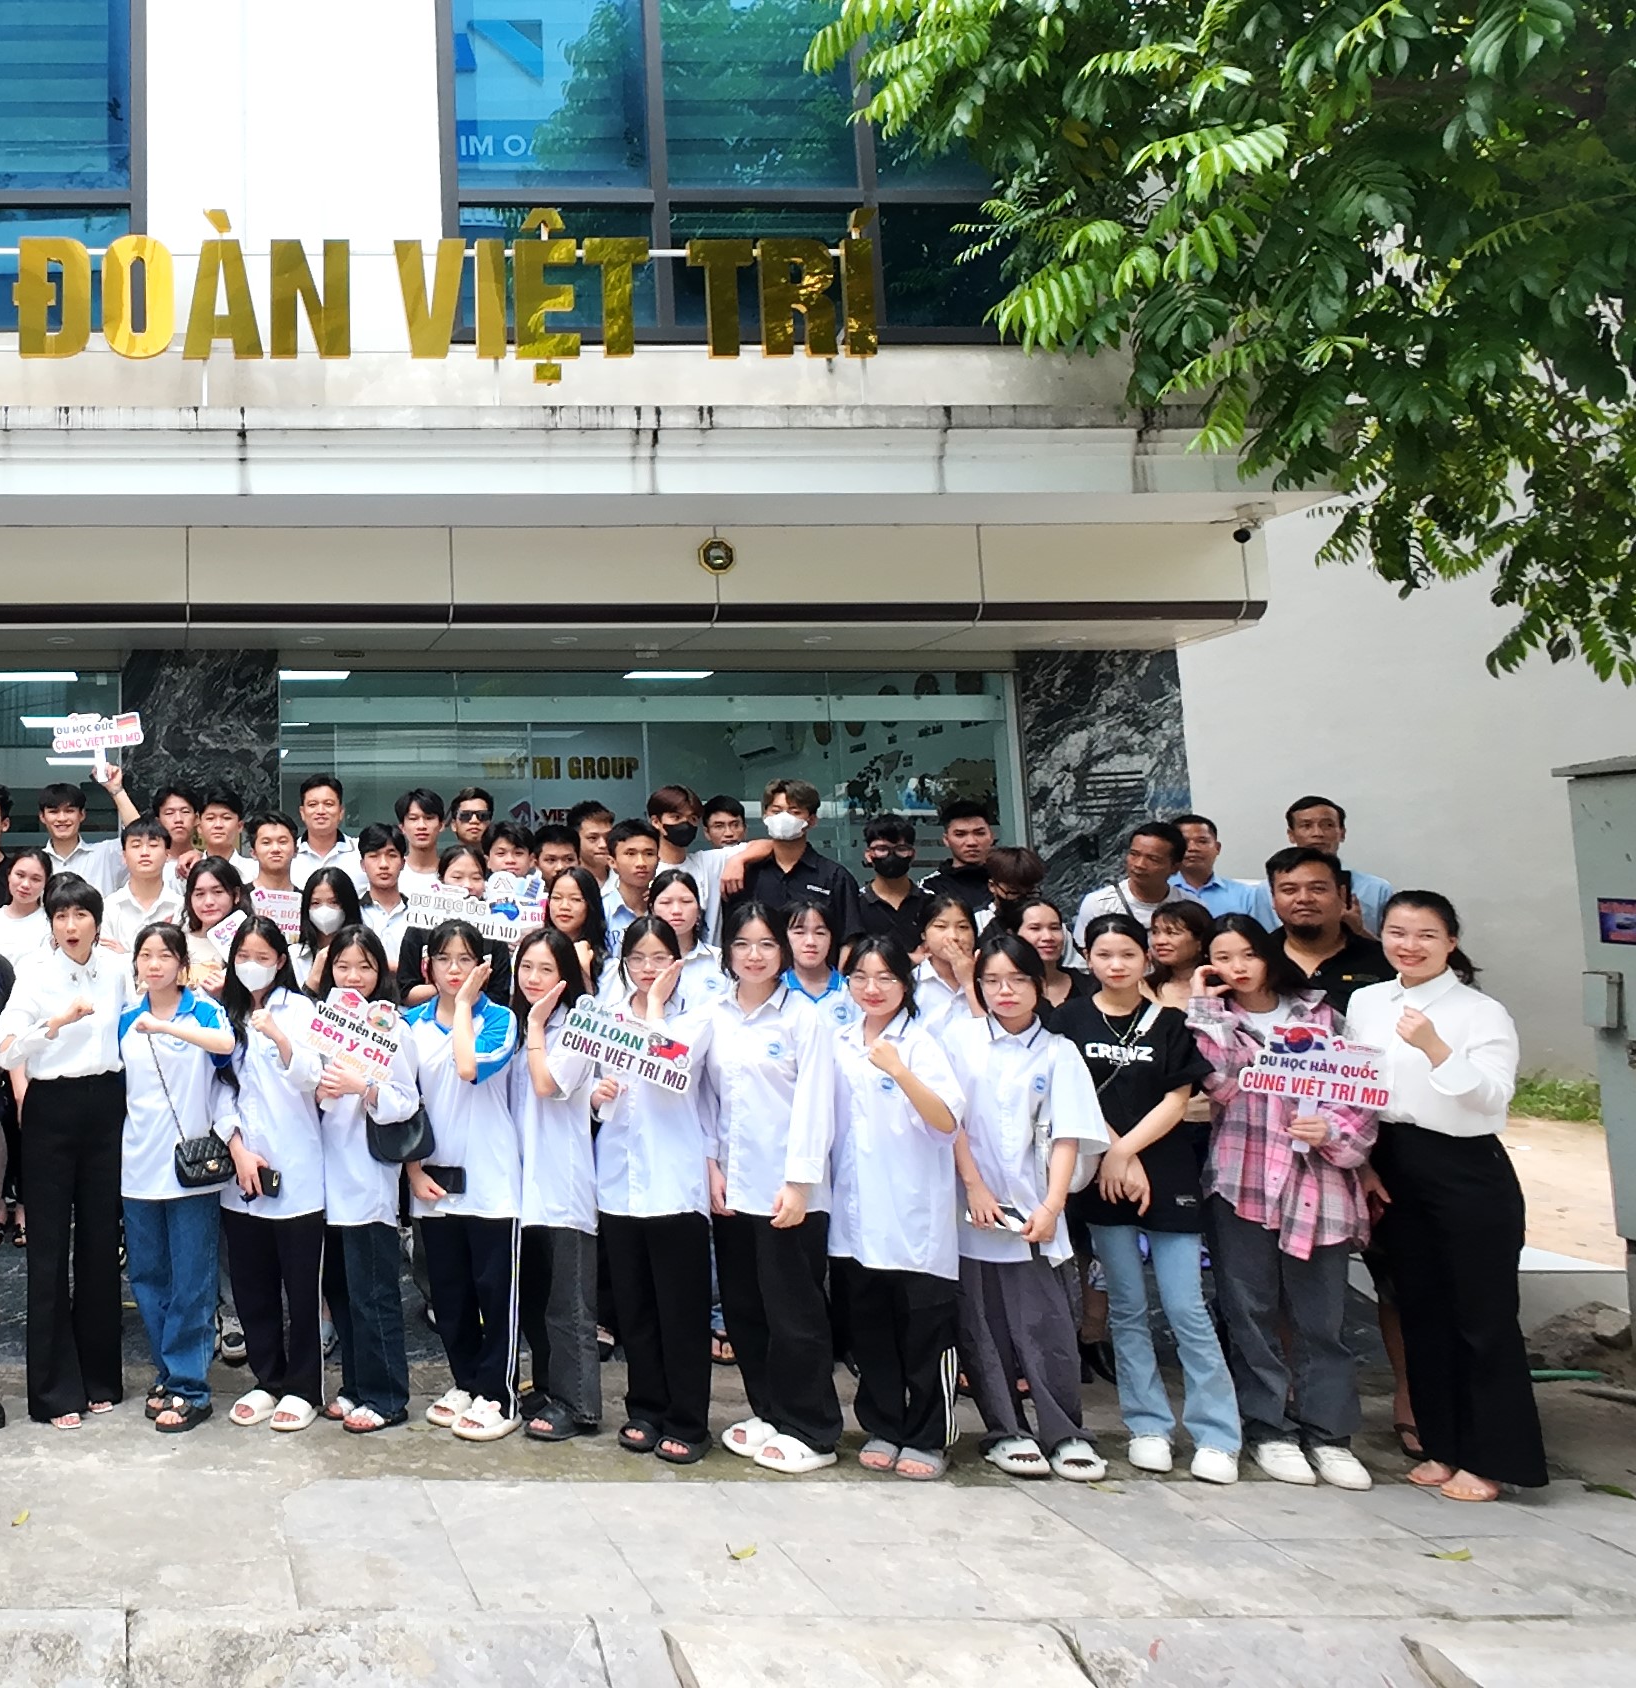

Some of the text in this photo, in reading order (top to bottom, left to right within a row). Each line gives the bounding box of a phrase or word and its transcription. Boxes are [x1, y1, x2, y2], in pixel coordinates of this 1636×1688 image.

[12, 208, 351, 360] ĐOÀN
[393, 208, 651, 385] VIỆT
[686, 207, 879, 360] TRÍ
[56, 726, 70, 735] DU
[125, 732, 141, 742] MD
[567, 756, 639, 780] GROUP
[410, 893, 432, 907] DU
[434, 897, 464, 914] HỌC
[406, 909, 438, 927] CÙNG
[499, 925, 518, 939] MD
[569, 1011, 599, 1034] ĐÀI
[599, 1024, 645, 1051] LOAN
[346, 1037, 361, 1053] ý
[362, 1046, 392, 1068] chí
[561, 1030, 688, 1091] CÙNG VIỆT TRÍ MD
[1259, 1054, 1379, 1081] DU HỌC HÀN QUỐC
[1243, 1069, 1390, 1107] CÙNG VIỆT TRÍ MD
